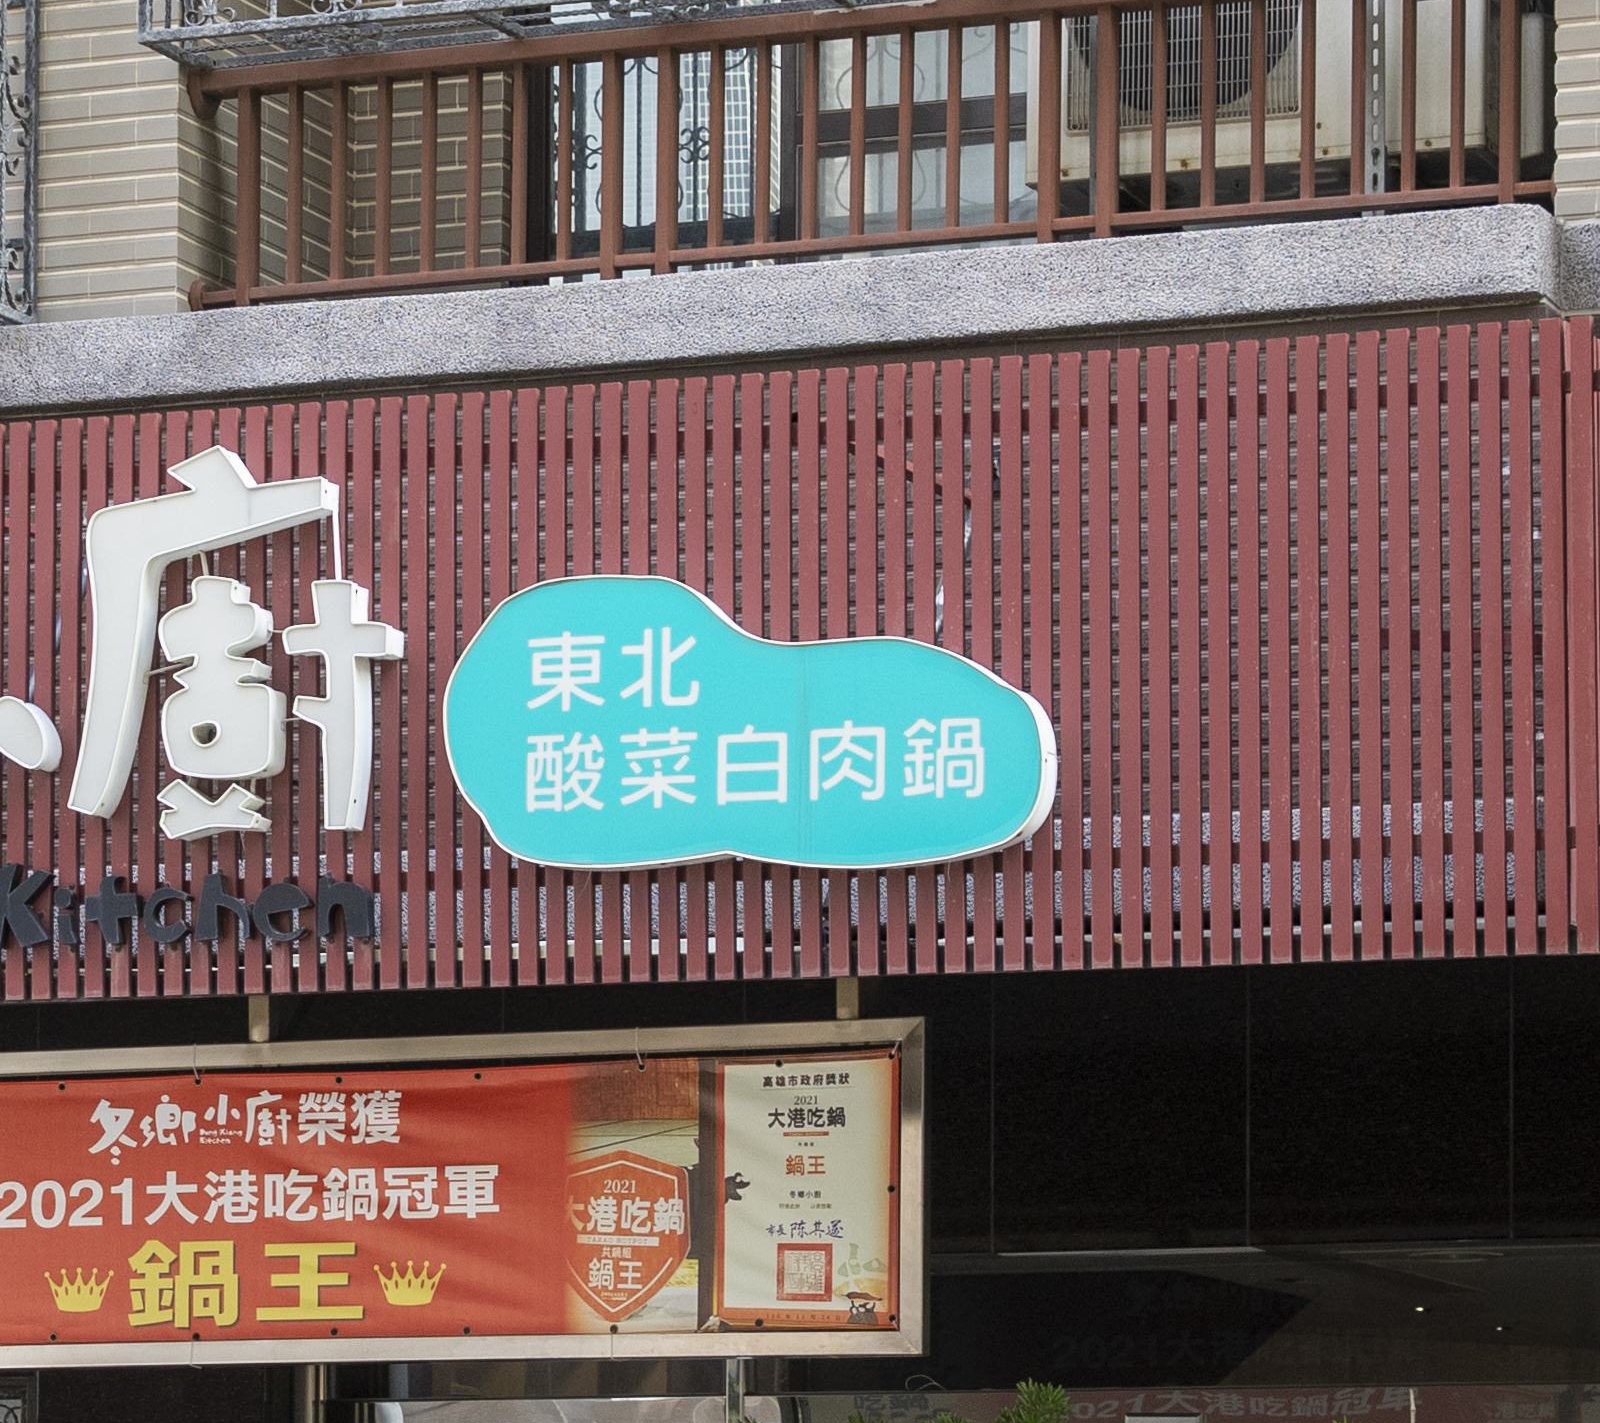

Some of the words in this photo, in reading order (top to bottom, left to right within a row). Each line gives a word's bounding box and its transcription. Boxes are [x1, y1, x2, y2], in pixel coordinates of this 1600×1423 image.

[527, 627, 699, 712] 東北
[526, 717, 985, 812] 酸菜白肉鍋
[794, 1095, 818, 1106] 2021
[768, 1107, 846, 1129] 大港吃鍋
[785, 1155, 826, 1176] 鍋王
[603, 1179, 636, 1193] 2021
[564, 1195, 685, 1235] 大港吃鍋
[127, 1239, 365, 1328] 鍋王
[588, 1258, 643, 1290] 鍋王
